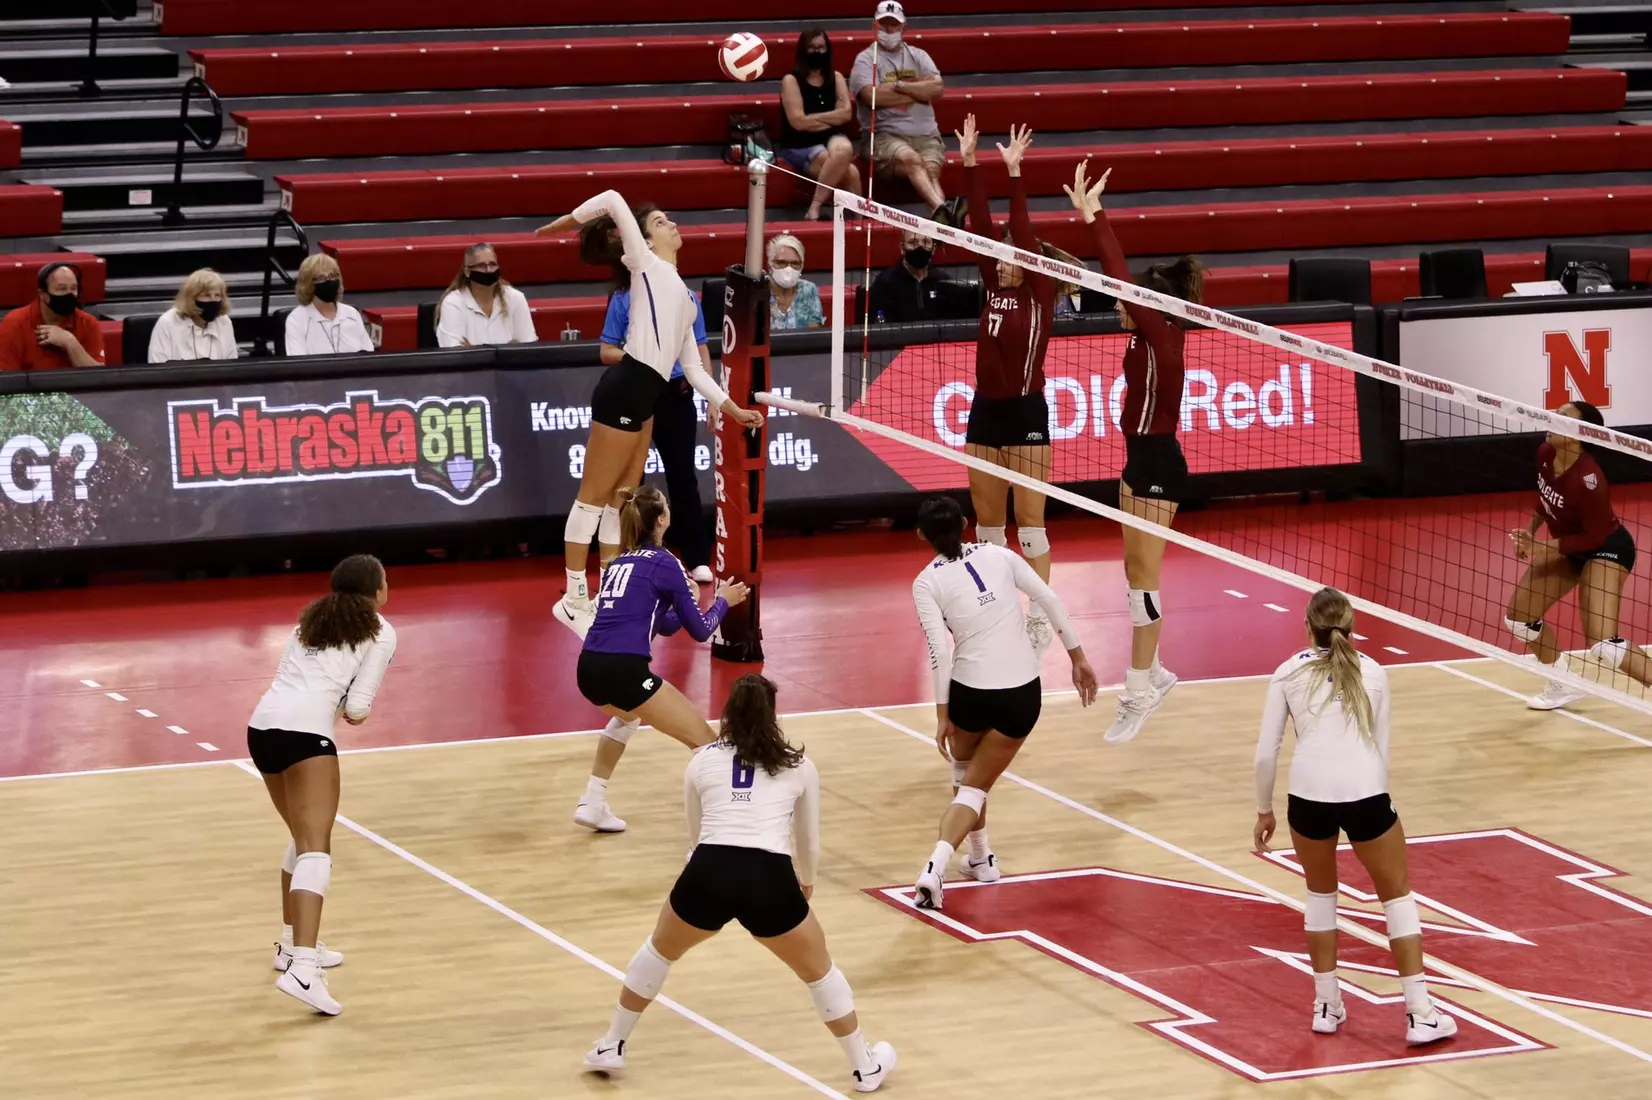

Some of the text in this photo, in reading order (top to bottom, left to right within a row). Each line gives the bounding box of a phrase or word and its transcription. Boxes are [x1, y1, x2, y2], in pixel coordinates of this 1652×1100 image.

[1372, 362, 1455, 395] HUSKER VOLLEYBALL
[1542, 328, 1612, 412] N
[1181, 364, 1315, 432] Red!
[177, 402, 485, 477] Nebraska 811
[768, 433, 819, 471] dig.
[0, 433, 98, 504] G?
[600, 563, 635, 598] 20
[964, 561, 987, 593] 1
